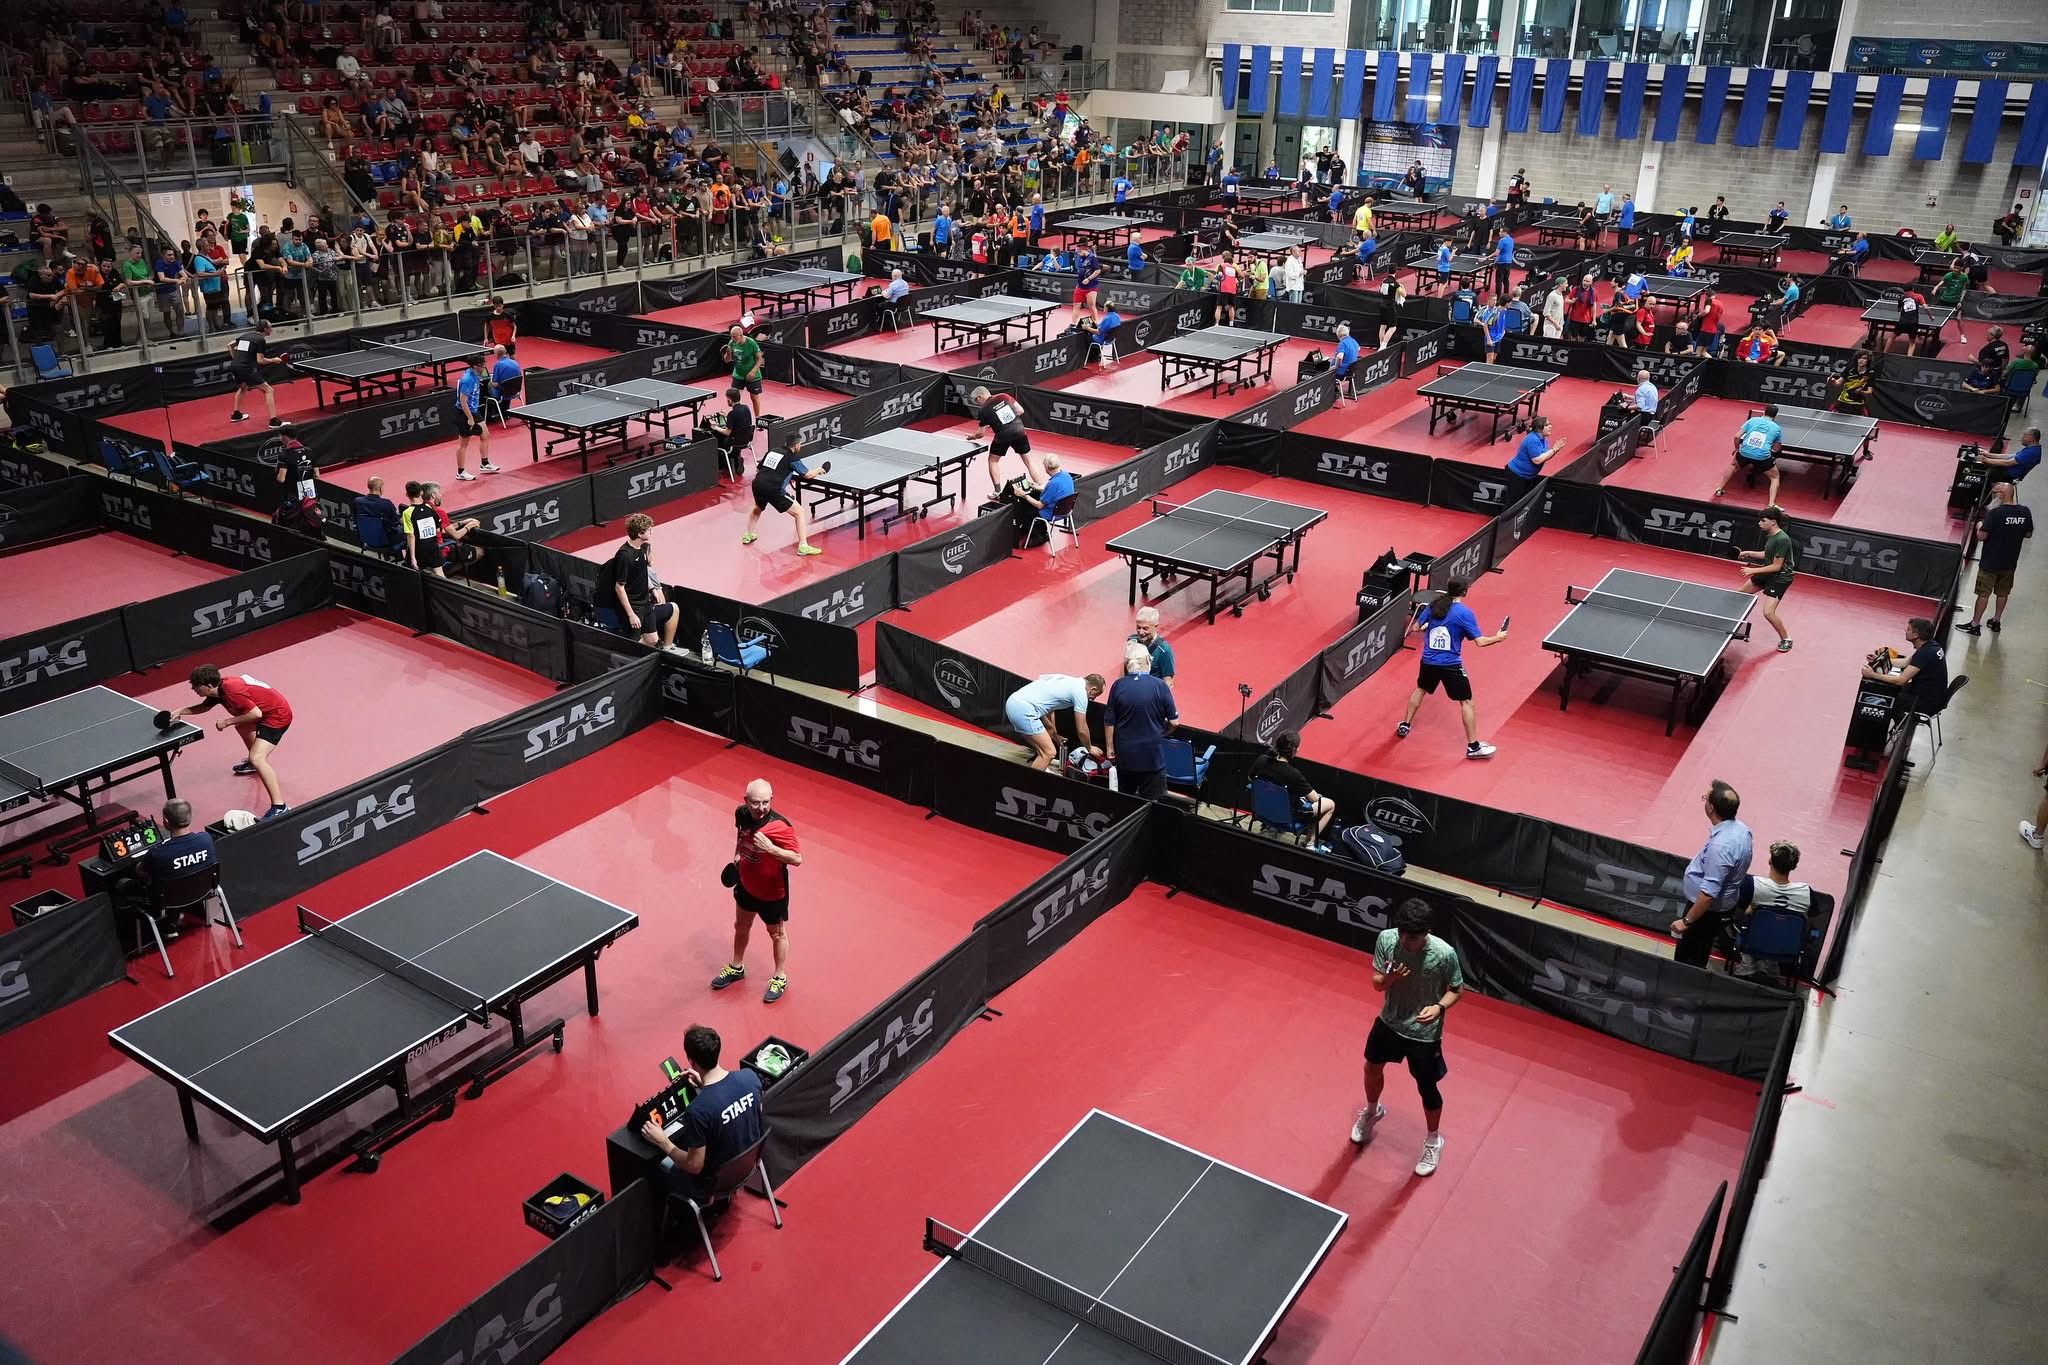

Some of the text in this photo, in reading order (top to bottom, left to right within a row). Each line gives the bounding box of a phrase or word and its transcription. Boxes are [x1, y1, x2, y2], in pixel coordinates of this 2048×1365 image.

[1821, 235, 1851, 248] STA
[551, 315, 592, 337] STAG
[827, 312, 859, 334] STAG
[652, 350, 697, 376] STAG
[1035, 348, 1068, 373] STAG
[1365, 357, 1391, 384] STAG
[1512, 343, 1569, 366] STAG
[1787, 354, 1849, 376] STAG
[820, 362, 871, 387] STAG
[1760, 376, 1827, 400] STAG
[881, 388, 923, 421] STAG
[1050, 402, 1110, 431] STAG
[1294, 387, 1321, 416] STAG
[379, 405, 441, 439] STAG
[800, 416, 842, 447] STAG
[1164, 440, 1200, 476] STAG
[1317, 452, 1389, 484] STAG
[628, 462, 686, 500] STAG
[1096, 470, 1139, 509] STAG
[492, 499, 560, 537] STAG
[1644, 507, 1732, 544] STAG
[2005, 516, 2026, 526] STAFF
[212, 523, 272, 562] STAG
[946, 541, 969, 558] FITET
[1801, 535, 1899, 574] STAG
[192, 584, 286, 638] STAG
[801, 583, 865, 624] STAG
[1344, 622, 1387, 680] STAG
[1432, 637, 1446, 650] 213
[0, 639, 87, 692] TAG
[940, 670, 972, 690] FITET
[523, 694, 616, 763] STAG
[1261, 708, 1282, 731] FITET
[785, 716, 880, 773] STAG
[297, 783, 416, 866] STAG
[995, 786, 1113, 843] STAG
[1375, 808, 1422, 829] FITET
[113, 828, 157, 858] 3 2 0 3
[173, 850, 208, 870] STAFF
[1027, 857, 1110, 940] STAG
[1252, 863, 1391, 933] STAG
[406, 1025, 458, 1064] ROMA 24
[829, 997, 935, 1115] STAG
[661, 1101, 669, 1112] 1
[669, 1095, 676, 1106] 1
[677, 1086, 690, 1108] 7
[720, 1092, 755, 1125] STAFF
